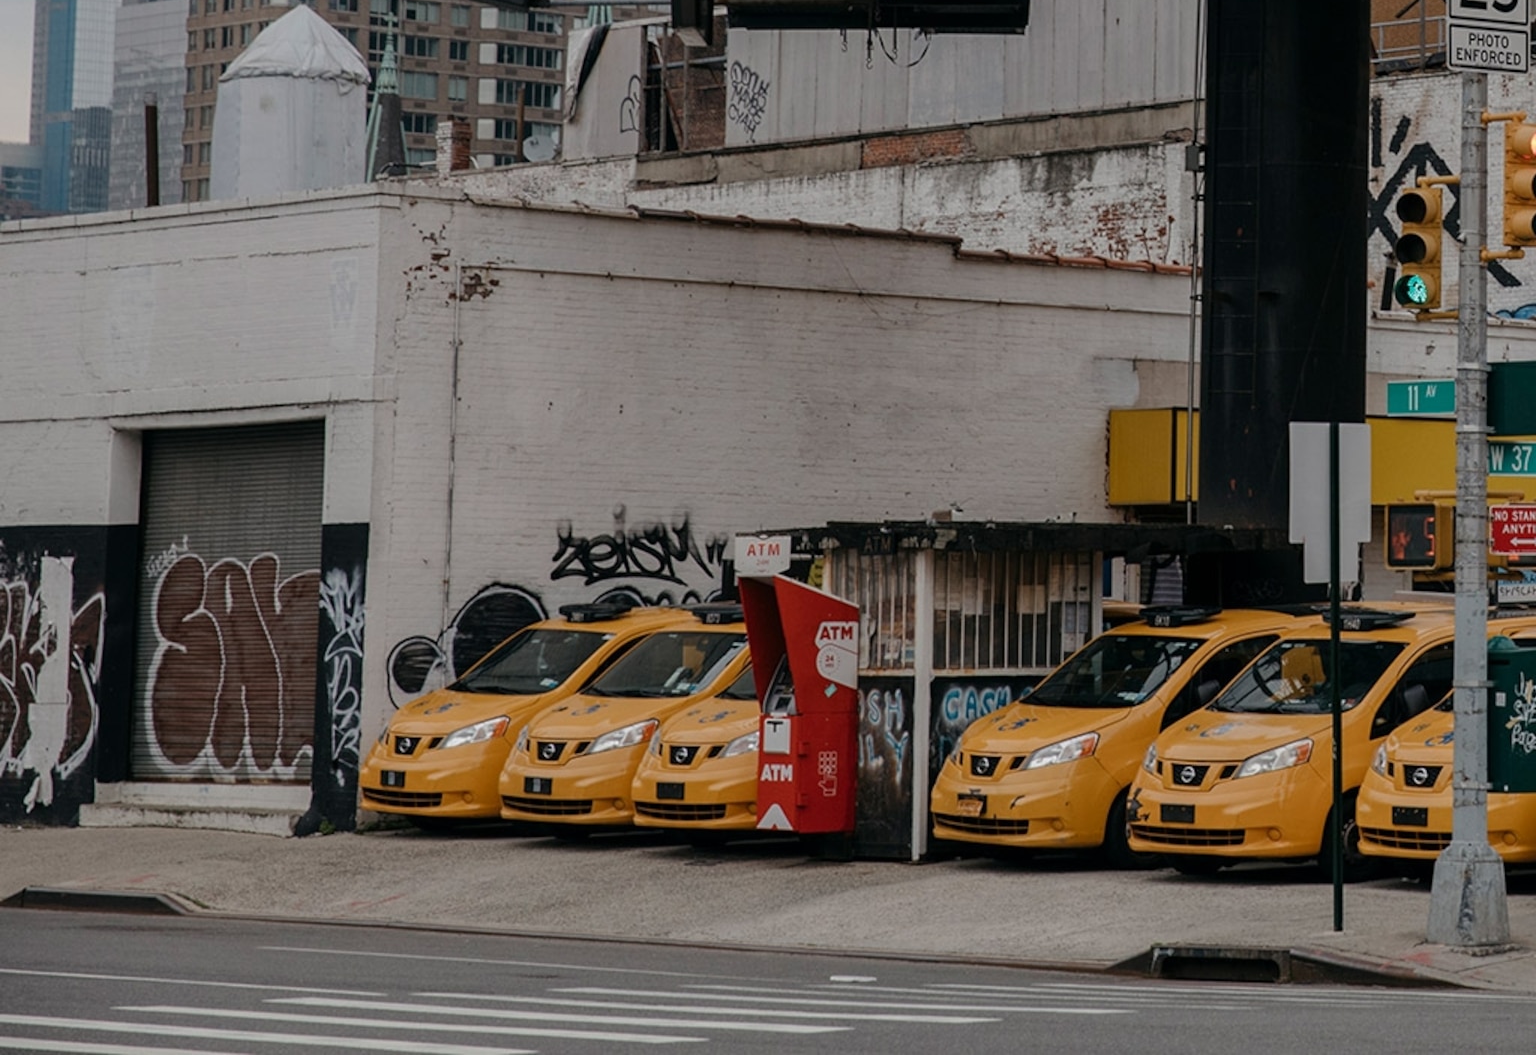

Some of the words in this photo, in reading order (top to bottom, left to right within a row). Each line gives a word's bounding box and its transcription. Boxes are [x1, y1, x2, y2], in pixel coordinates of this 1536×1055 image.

[1468, 32, 1509, 50] PHOTO
[1456, 48, 1522, 67] ENFORCED
[1407, 385, 1419, 411] 11
[1426, 386, 1437, 397] AV
[1491, 447, 1505, 471] W
[1511, 446, 1531, 472] 37
[1494, 510, 1508, 522] NO
[747, 543, 780, 557] ATM
[820, 627, 854, 640] ATM
[761, 764, 793, 782] ATM
